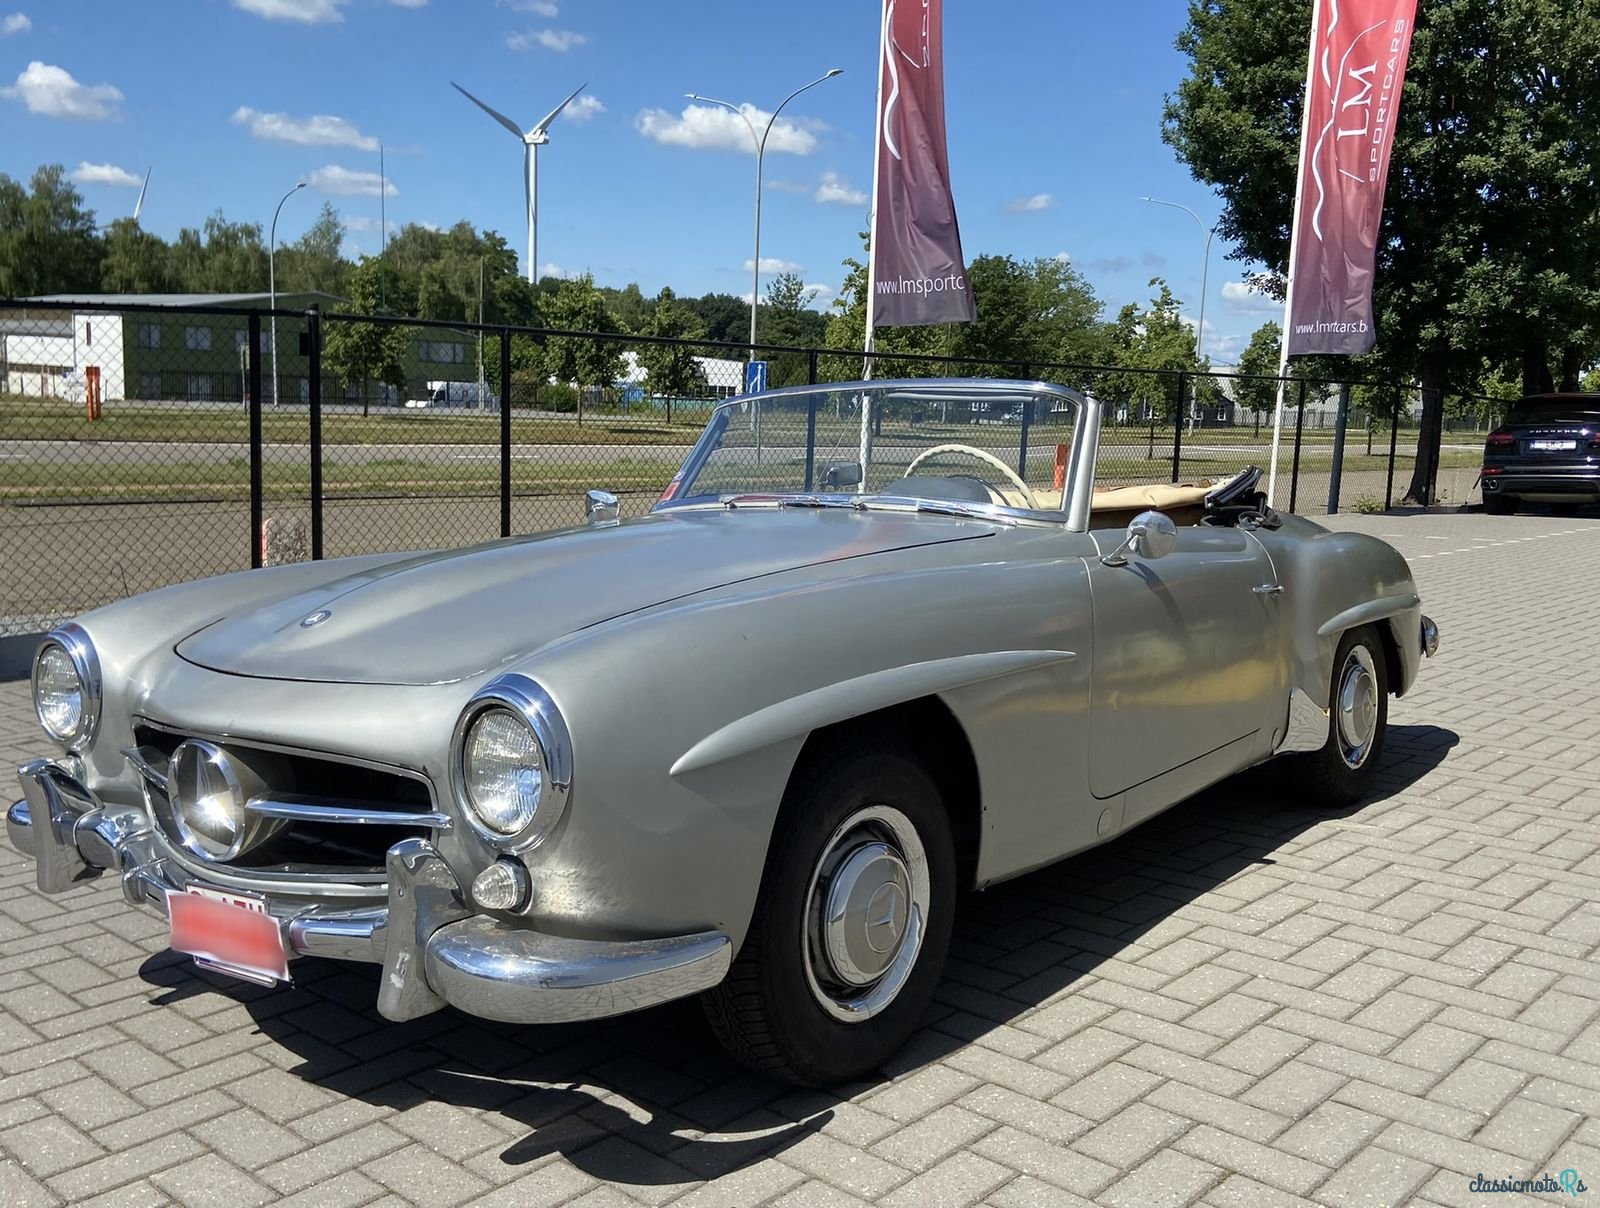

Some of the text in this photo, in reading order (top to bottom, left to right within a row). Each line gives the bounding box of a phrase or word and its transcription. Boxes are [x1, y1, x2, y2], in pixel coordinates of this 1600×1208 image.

[1336, 60, 1378, 141] LM
[1369, 19, 1405, 182] SPORTCARS
[876, 274, 966, 298] www.lmsportc
